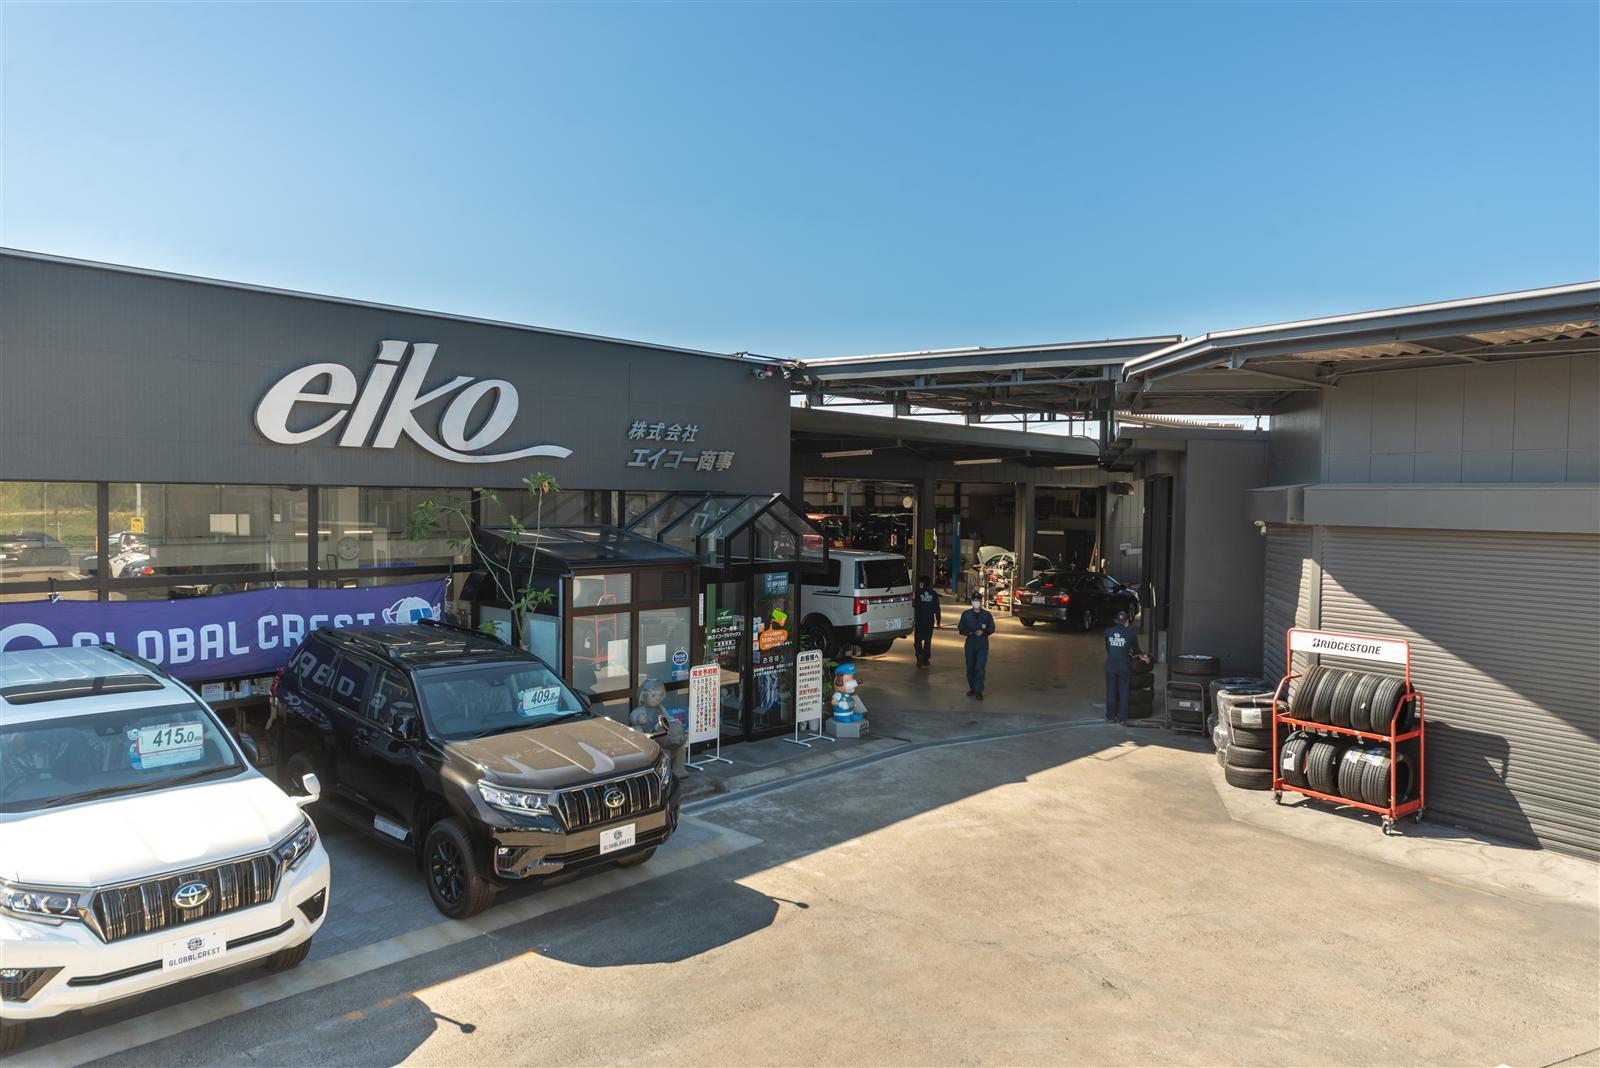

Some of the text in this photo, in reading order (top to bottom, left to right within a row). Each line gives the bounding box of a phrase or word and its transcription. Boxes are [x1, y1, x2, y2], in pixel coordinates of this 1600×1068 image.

[254, 340, 573, 463] eiko
[628, 420, 699, 442] 株式会社
[627, 448, 736, 472] エイコー商事
[1312, 638, 1382, 655] BRIDGESTONE
